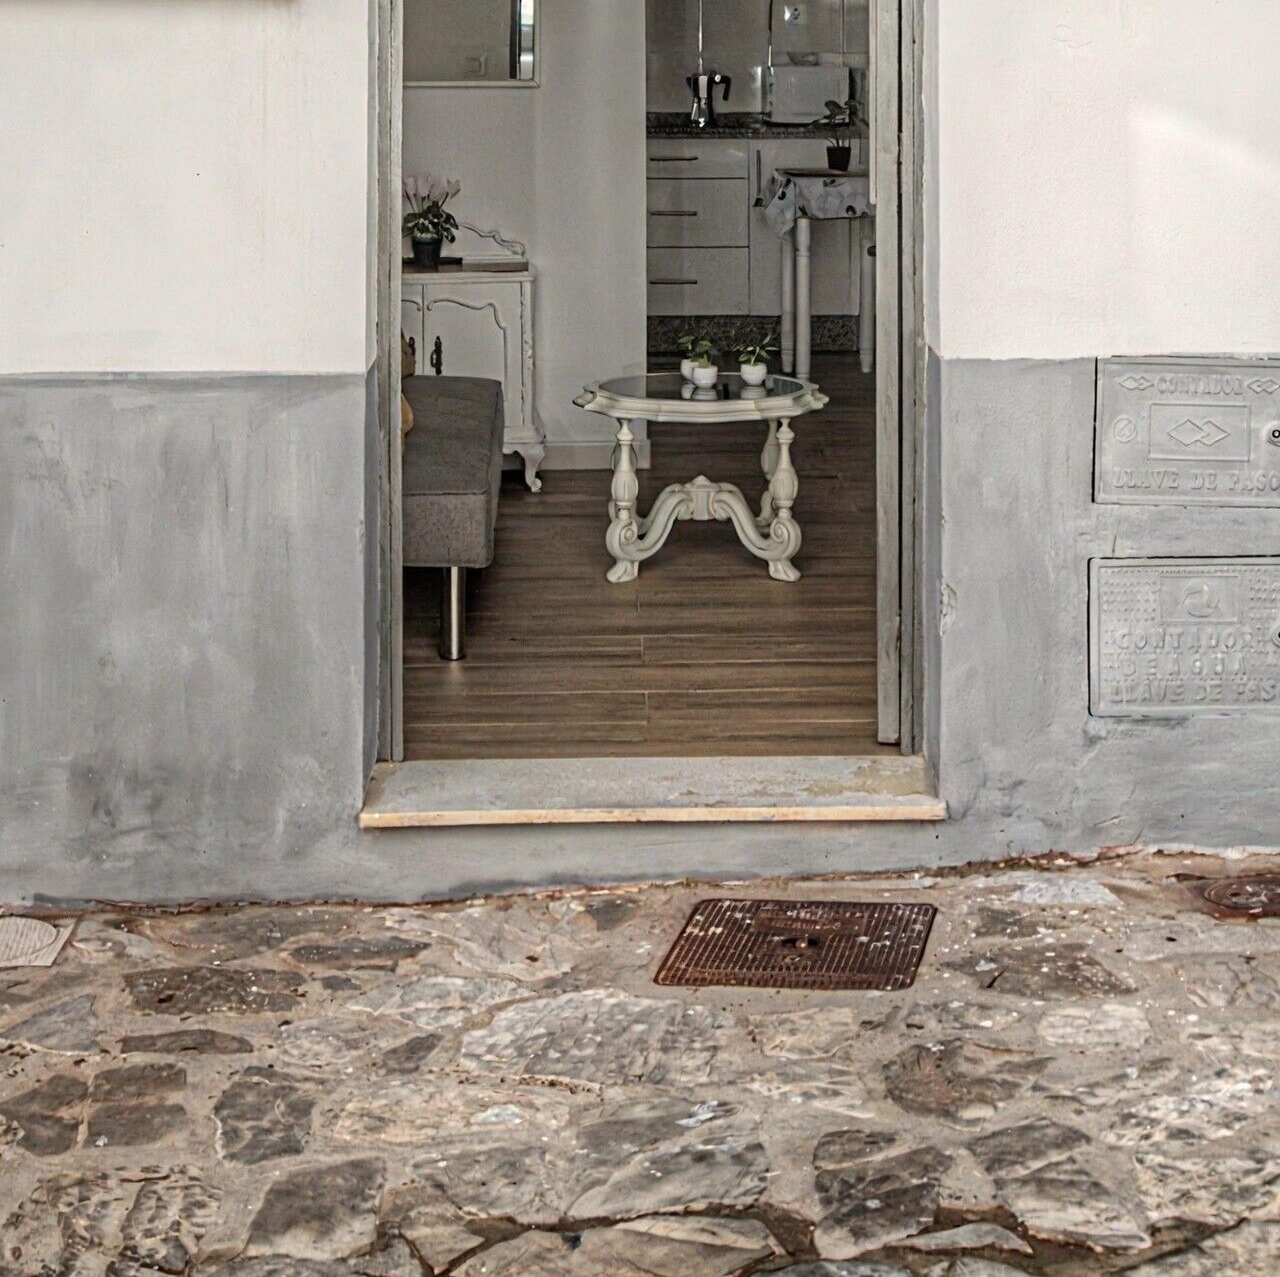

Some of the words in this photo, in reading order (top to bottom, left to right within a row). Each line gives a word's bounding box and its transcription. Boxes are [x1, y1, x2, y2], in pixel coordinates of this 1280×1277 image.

[1157, 374, 1244, 396] CONTADOR
[1112, 468, 1180, 491] LLAVE
[1190, 469, 1218, 491] DE
[1115, 628, 1255, 651] CONTADOR
[1109, 682, 1185, 703] LLAVE
[1194, 683, 1223, 703] DE
